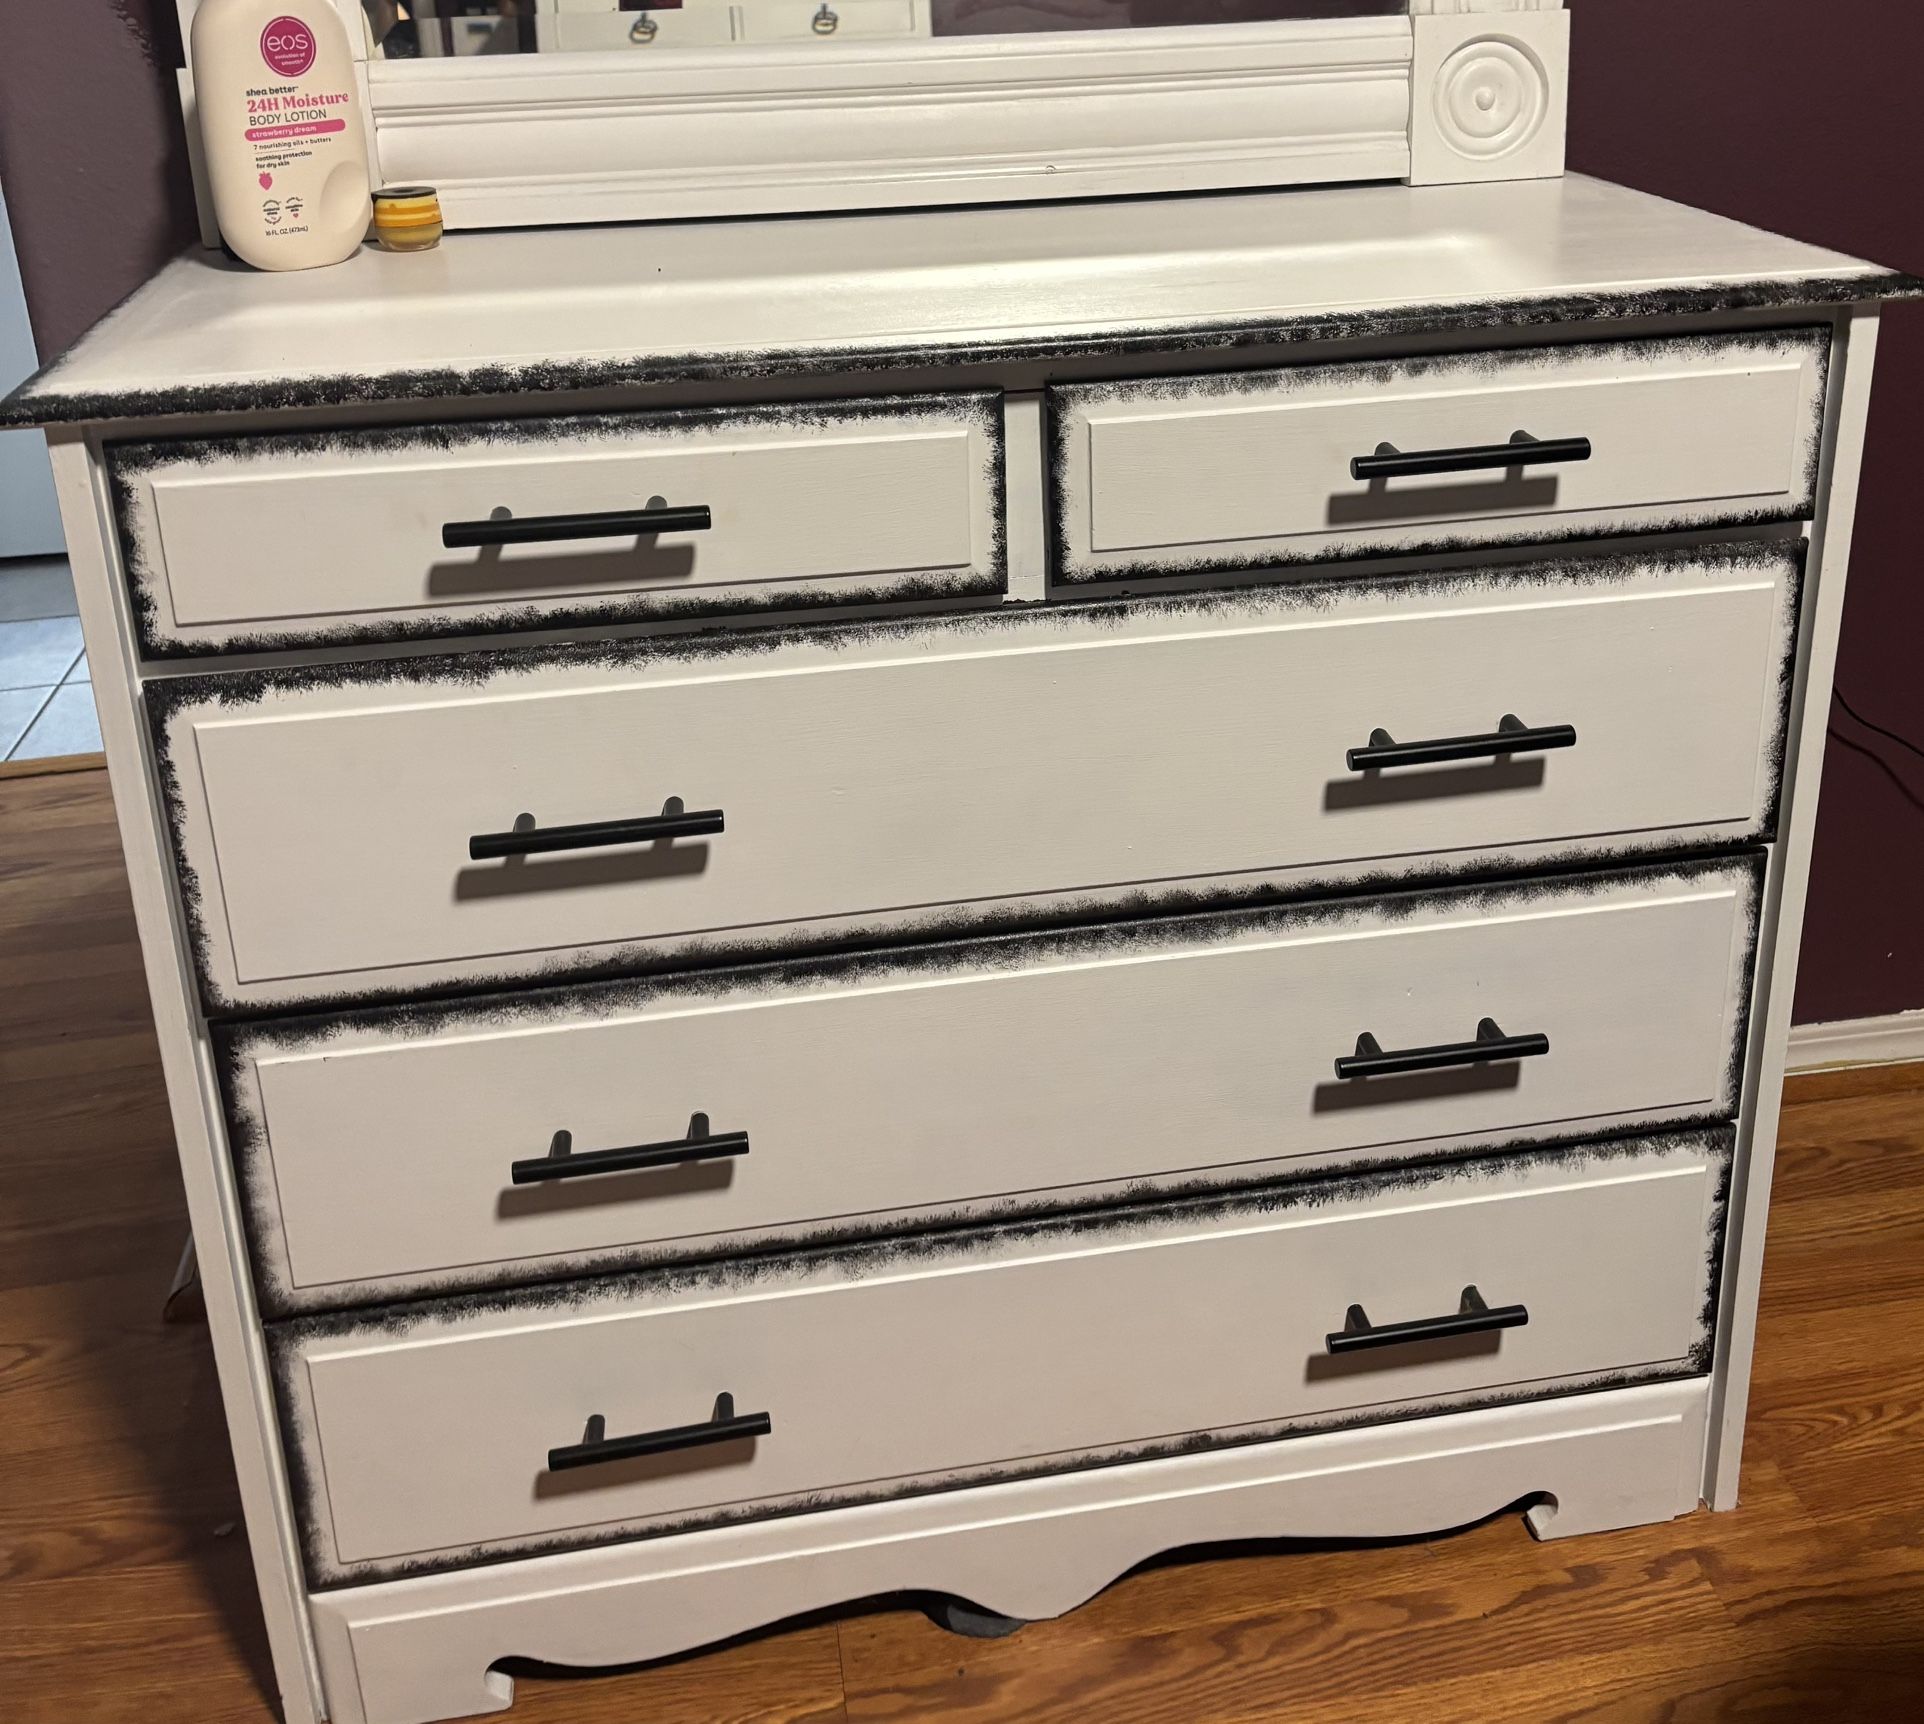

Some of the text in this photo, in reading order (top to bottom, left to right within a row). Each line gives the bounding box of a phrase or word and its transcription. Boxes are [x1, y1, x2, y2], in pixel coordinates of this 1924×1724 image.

[267, 33, 308, 51] eos
[246, 89, 267, 97] shea
[247, 93, 349, 113] 24H Moisture
[249, 109, 327, 126] BODY LOTION
[252, 126, 317, 139] strawberry dream
[259, 141, 292, 149] nourishing
[255, 151, 313, 162] soothing protection
